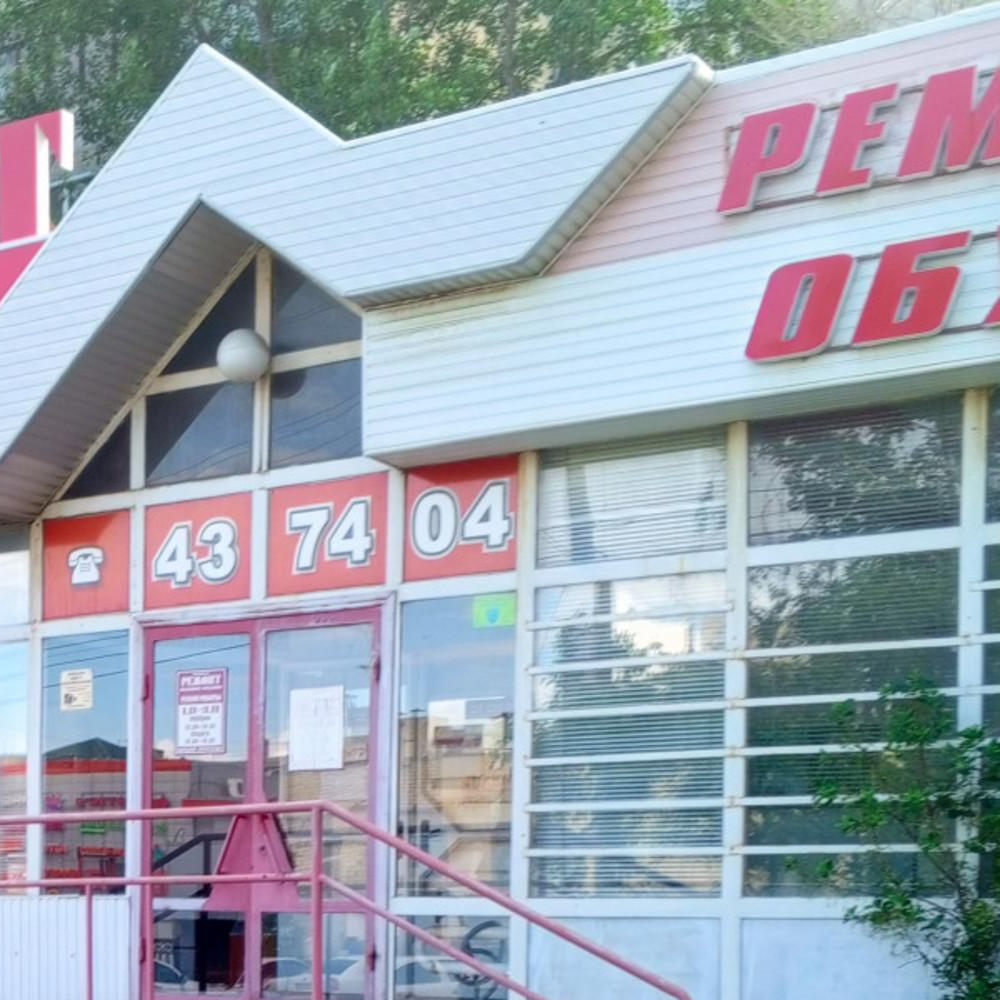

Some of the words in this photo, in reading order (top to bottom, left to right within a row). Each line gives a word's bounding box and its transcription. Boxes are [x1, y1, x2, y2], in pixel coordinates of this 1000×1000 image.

[152, 516, 240, 589] 43
[287, 496, 376, 576] 74
[409, 479, 516, 560] 04
